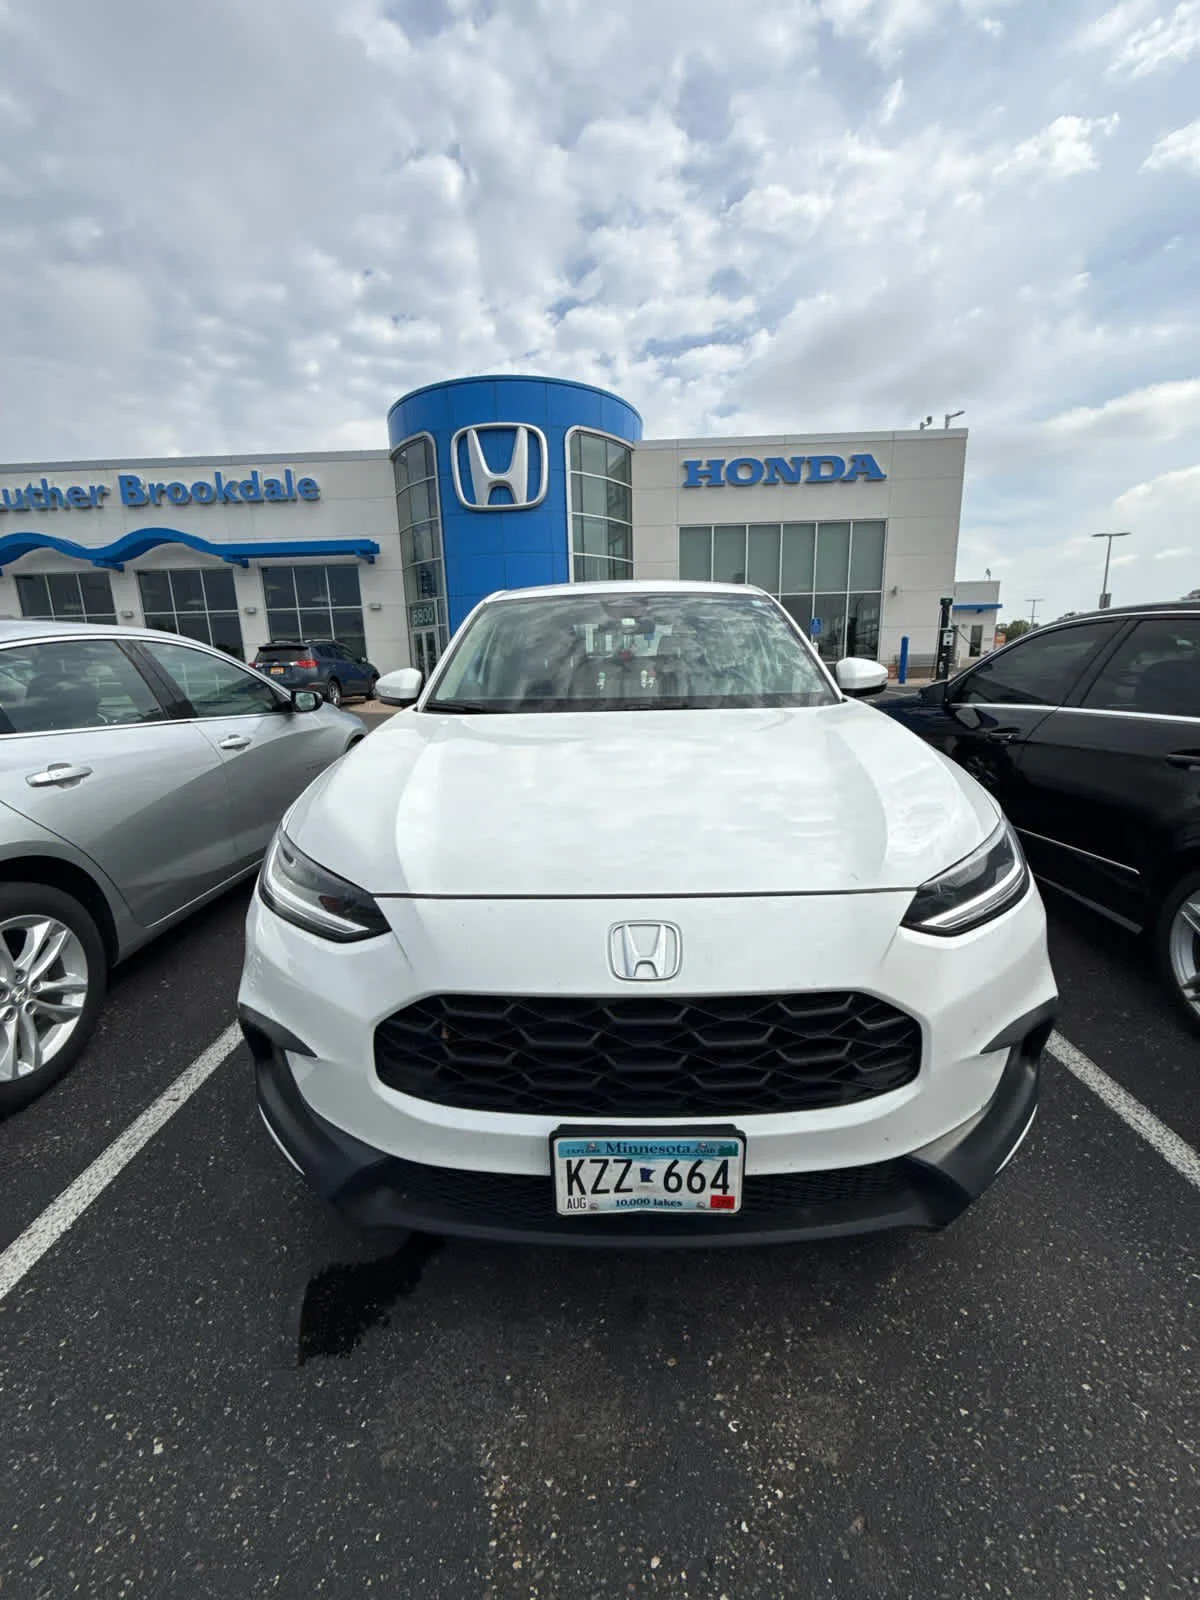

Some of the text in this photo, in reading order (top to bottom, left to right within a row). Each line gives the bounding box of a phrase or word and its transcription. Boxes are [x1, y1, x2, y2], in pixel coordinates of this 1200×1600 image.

[682, 453, 888, 488] HONDA
[0, 468, 321, 512] uther Brookdale
[606, 1141, 691, 1154] Minnesota
[566, 1158, 730, 1196] KZZ 664
[567, 1196, 587, 1210] AUG
[653, 1197, 683, 1207] lakes
